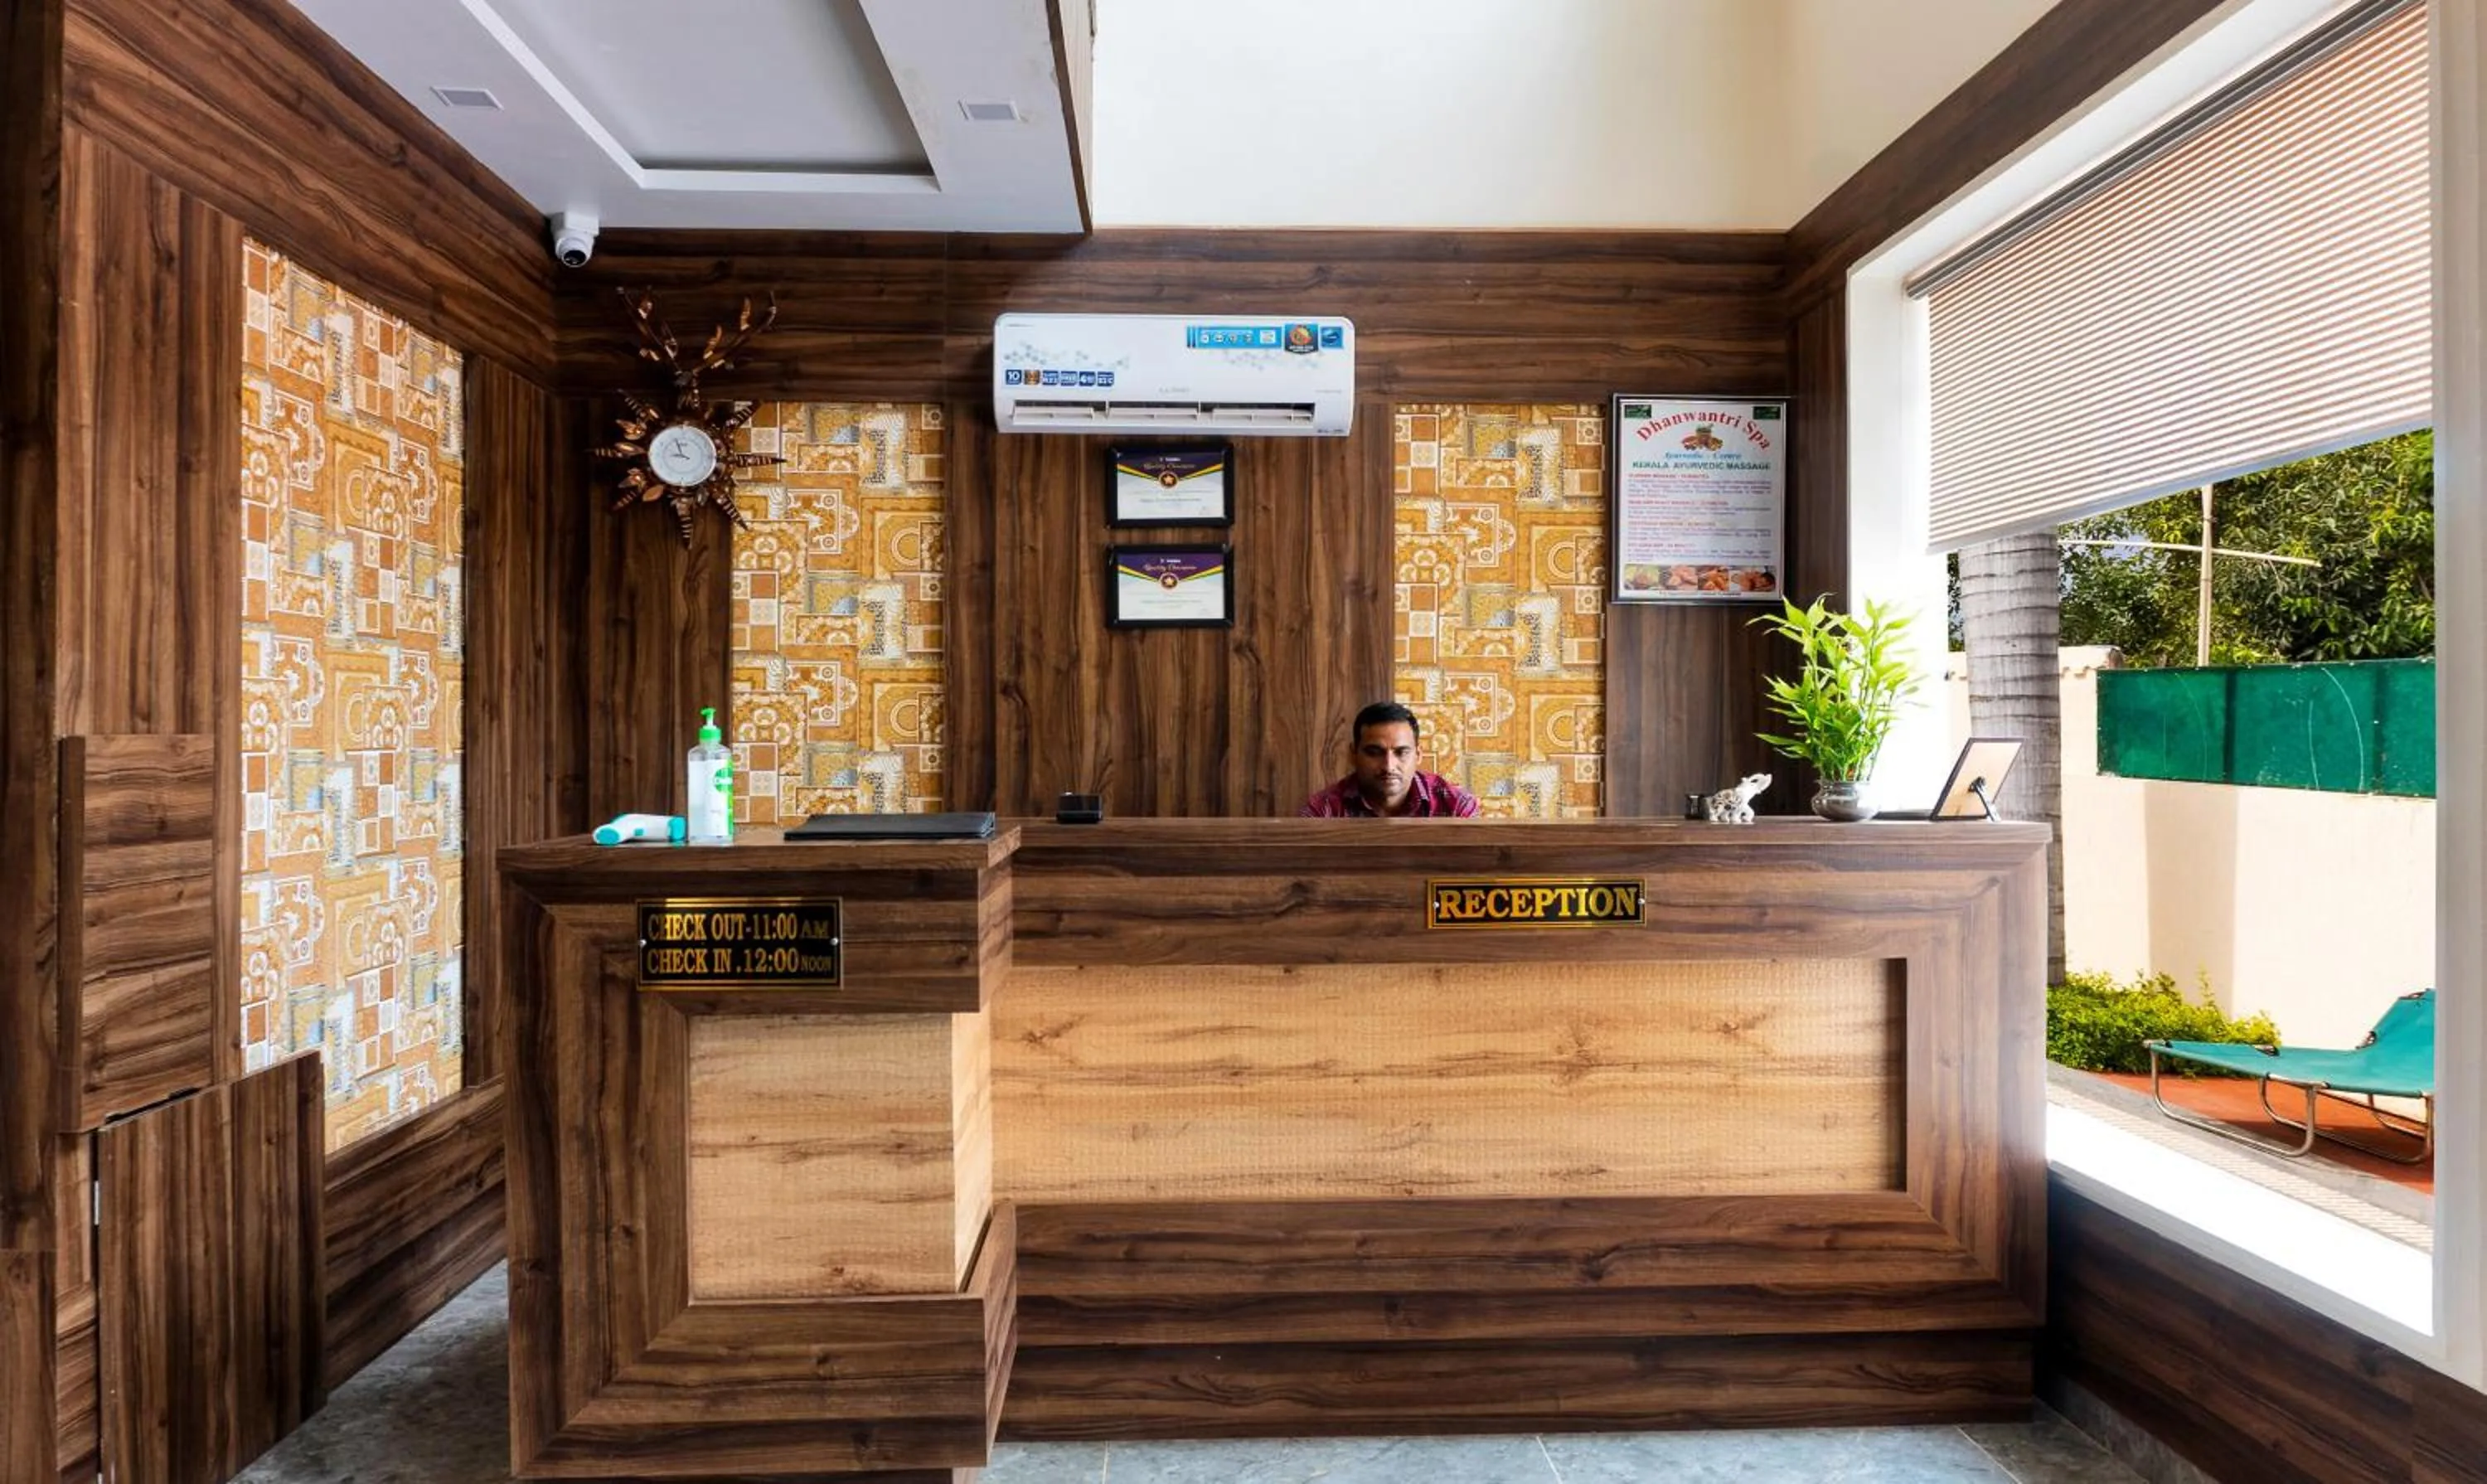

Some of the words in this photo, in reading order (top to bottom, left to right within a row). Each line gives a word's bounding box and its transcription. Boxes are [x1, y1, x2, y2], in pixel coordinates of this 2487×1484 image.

[1636, 411, 1742, 442] Dhanwantri
[1745, 420, 1771, 450] Spa
[1632, 461, 1670, 469] KERALA
[1673, 461, 1725, 470] AYURVEDIC
[1726, 462, 1771, 471] MASSAGE
[1438, 886, 1637, 919] RECEPTION
[647, 913, 707, 941] CHECK
[801, 919, 829, 939] AM
[647, 948, 708, 974] CHECK
[713, 948, 732, 973] IN
[800, 958, 832, 973] NOON
